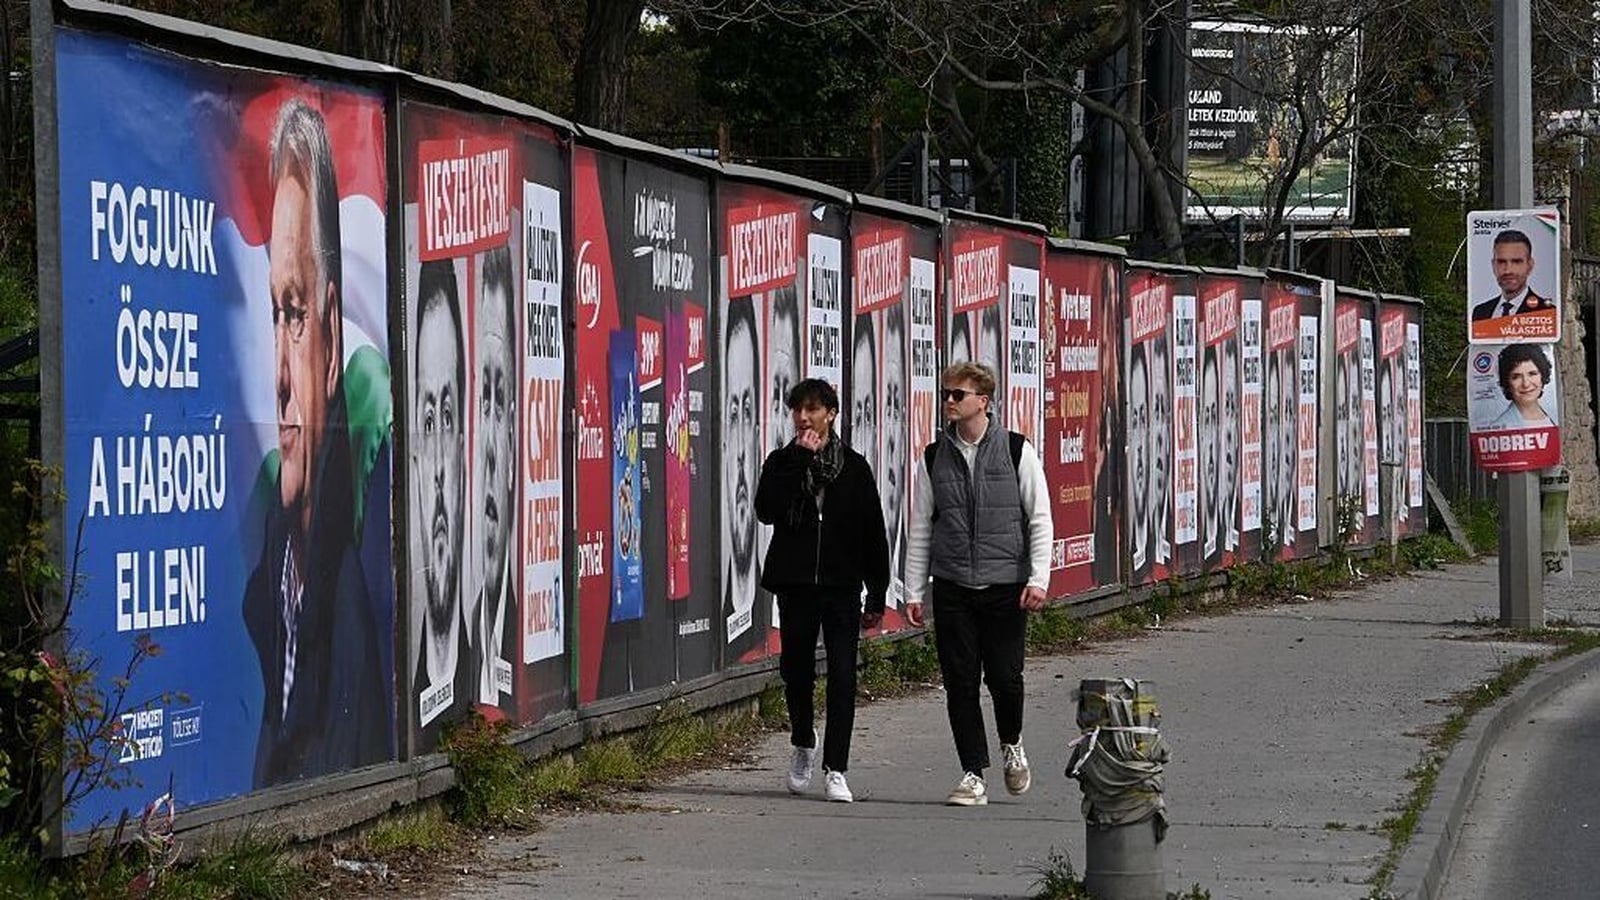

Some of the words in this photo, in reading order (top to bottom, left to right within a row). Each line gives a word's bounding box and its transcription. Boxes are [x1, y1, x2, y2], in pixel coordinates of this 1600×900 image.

[91, 180, 218, 275] FOGJUNK
[423, 139, 509, 250] VESZÉLYESEK!
[1473, 218, 1512, 230] Steiner
[731, 204, 797, 291] VESZÉLYESEK!
[116, 285, 200, 389] ÖSSZE
[88, 436, 109, 518] A
[117, 414, 227, 516] HÁBORÚ
[528, 378, 561, 483] CSAK
[1477, 432, 1550, 454] DOBREV
[116, 545, 206, 633] ELLEN!
